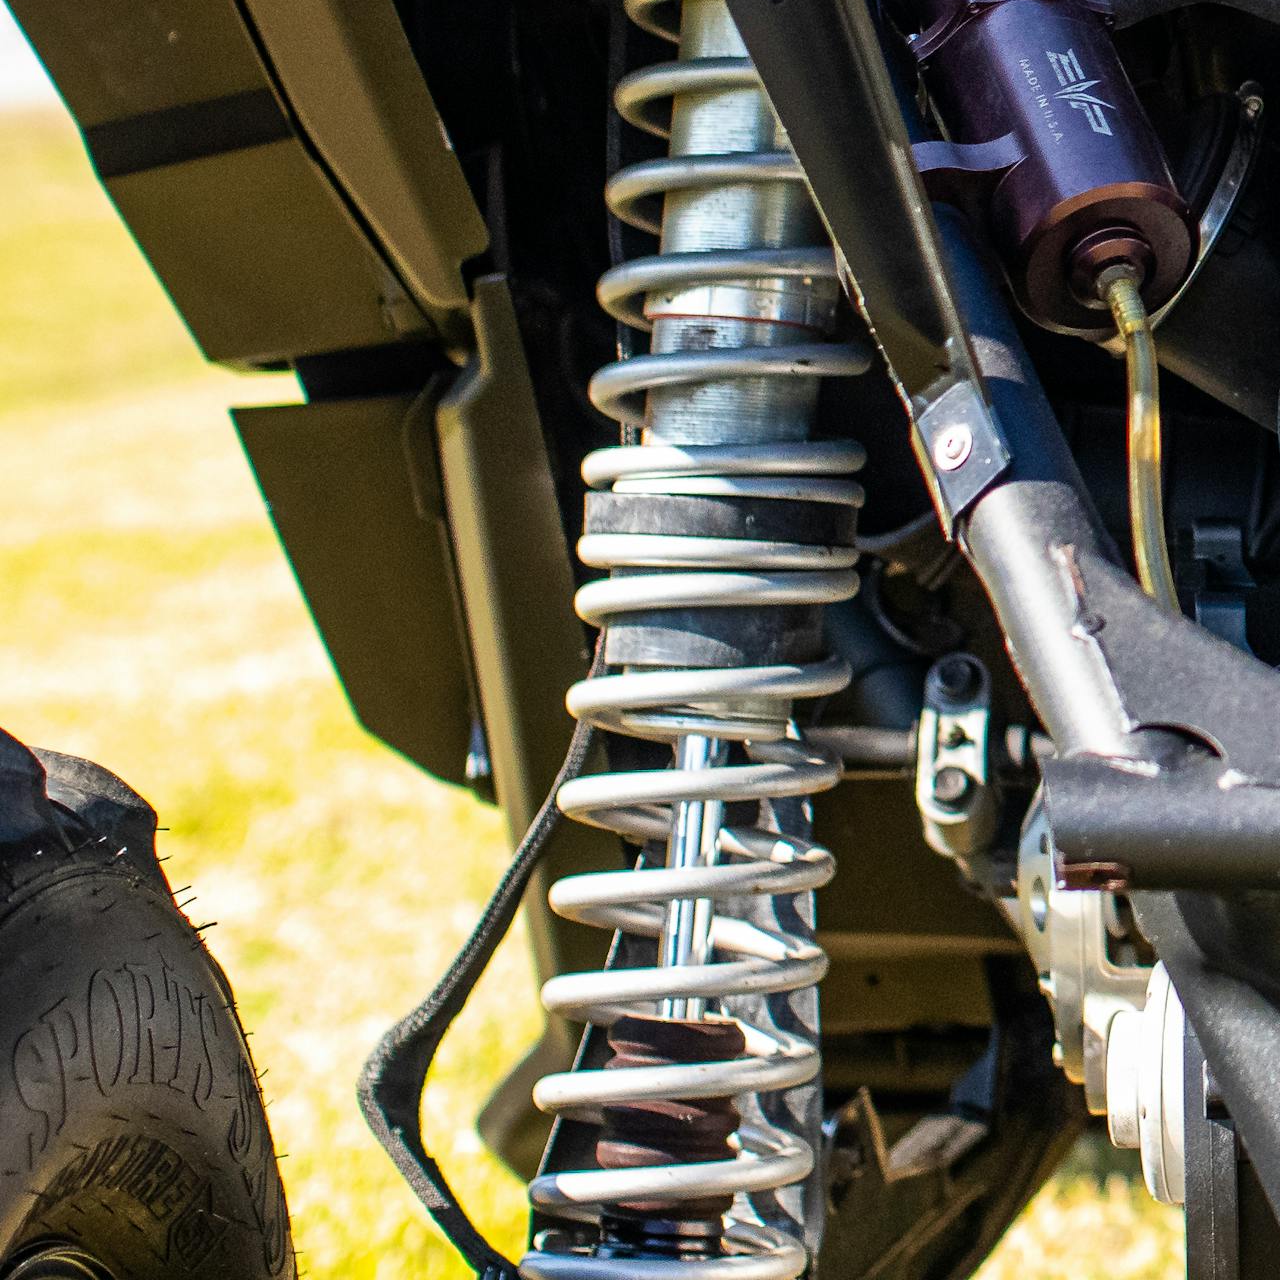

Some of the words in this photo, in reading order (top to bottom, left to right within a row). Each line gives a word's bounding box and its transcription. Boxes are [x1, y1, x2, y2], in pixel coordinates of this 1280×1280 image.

[1018, 58, 1043, 96] MADE
[1035, 93, 1050, 108] IN
[1045, 48, 1117, 136] EVP
